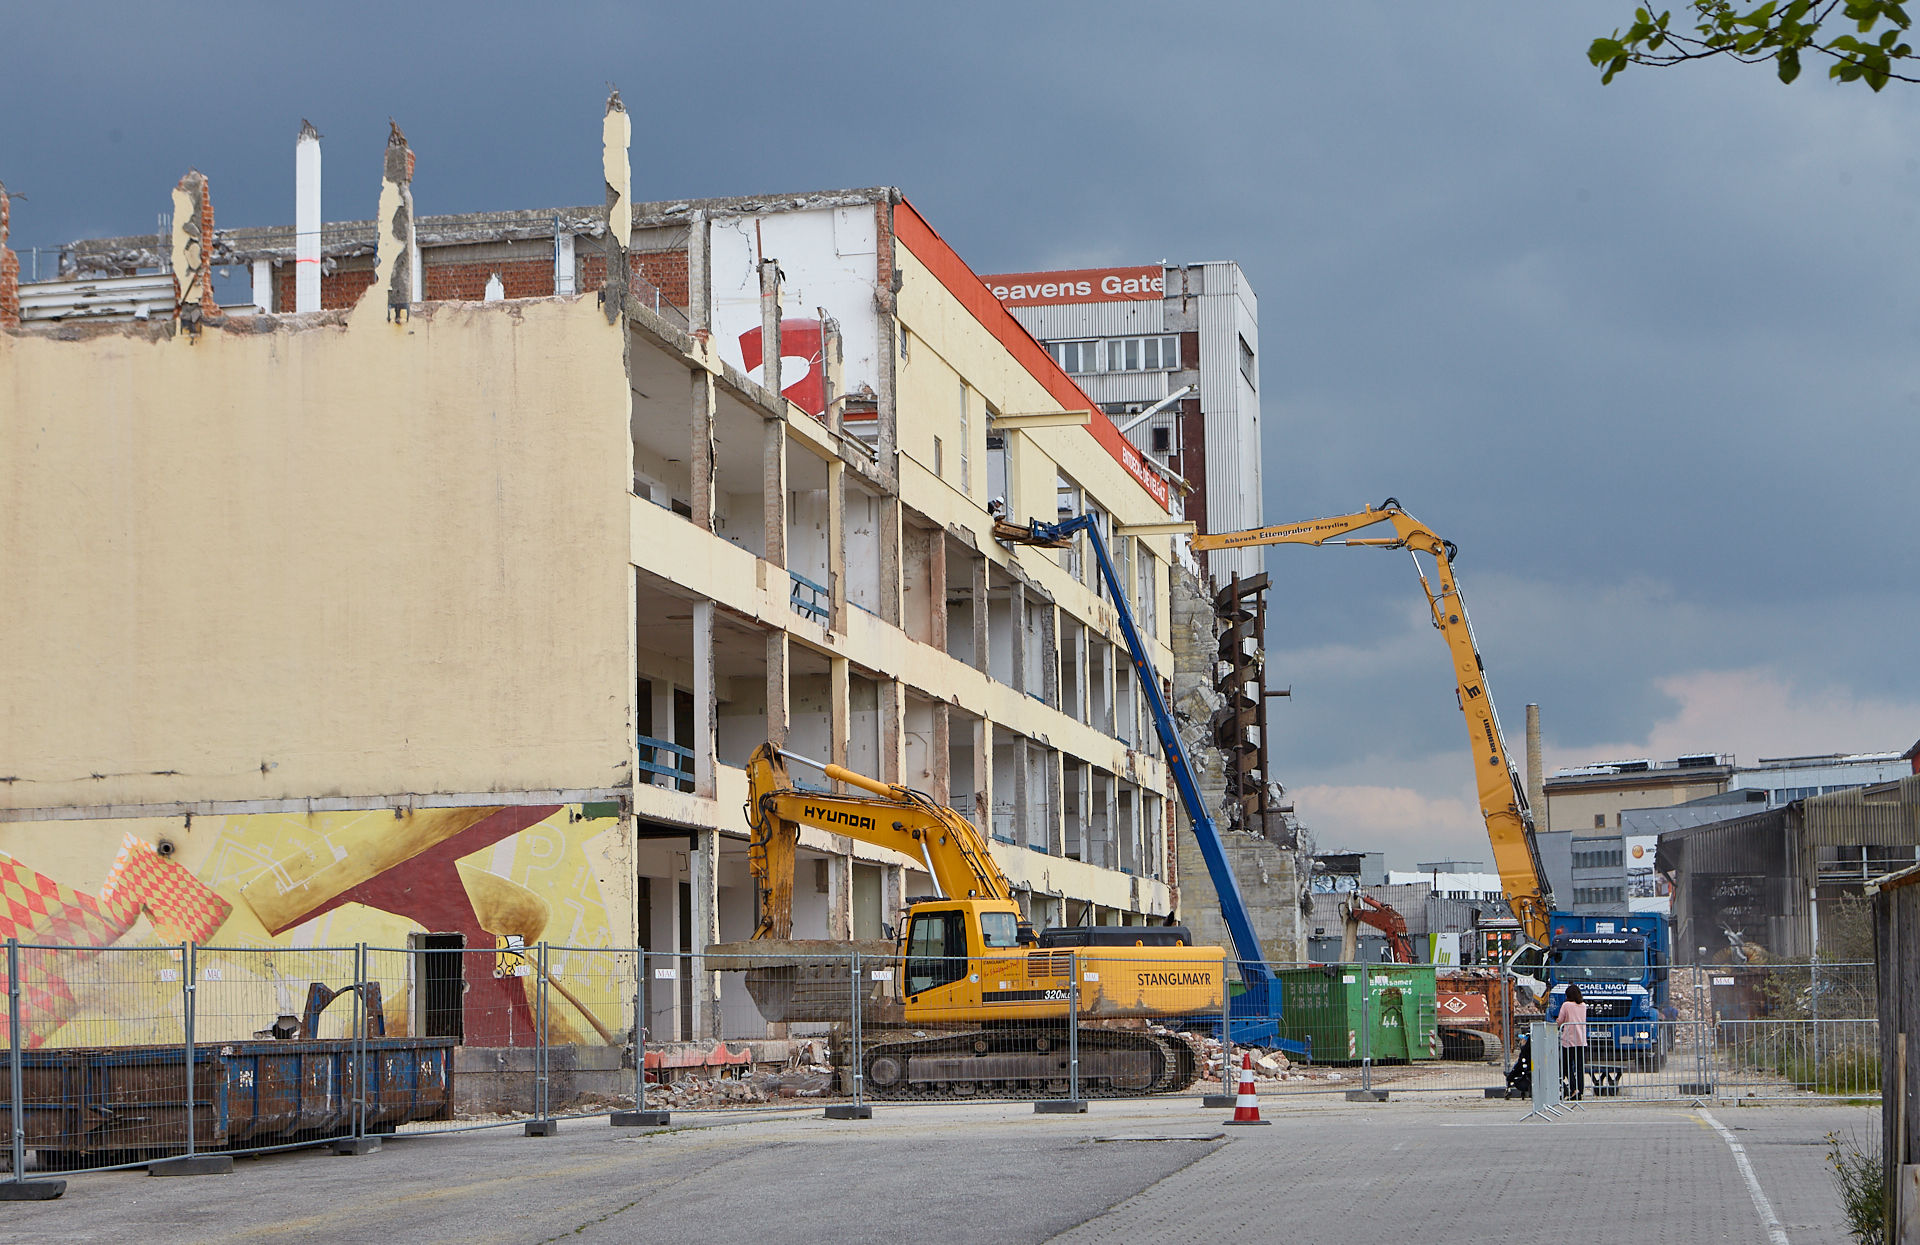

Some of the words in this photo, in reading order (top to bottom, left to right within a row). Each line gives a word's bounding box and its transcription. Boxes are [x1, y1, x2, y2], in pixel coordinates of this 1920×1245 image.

[1101, 275, 1163, 295] Gate
[1225, 535, 1257, 544] Abbruch
[1259, 526, 1313, 540] Ettengruber
[1315, 521, 1349, 531] Recycling
[1483, 719, 1496, 753] LIEBHERR
[804, 805, 875, 830] HYUNDAI
[1137, 973, 1211, 986] STANGLMAYR
[1382, 1015, 1398, 1028] 44
